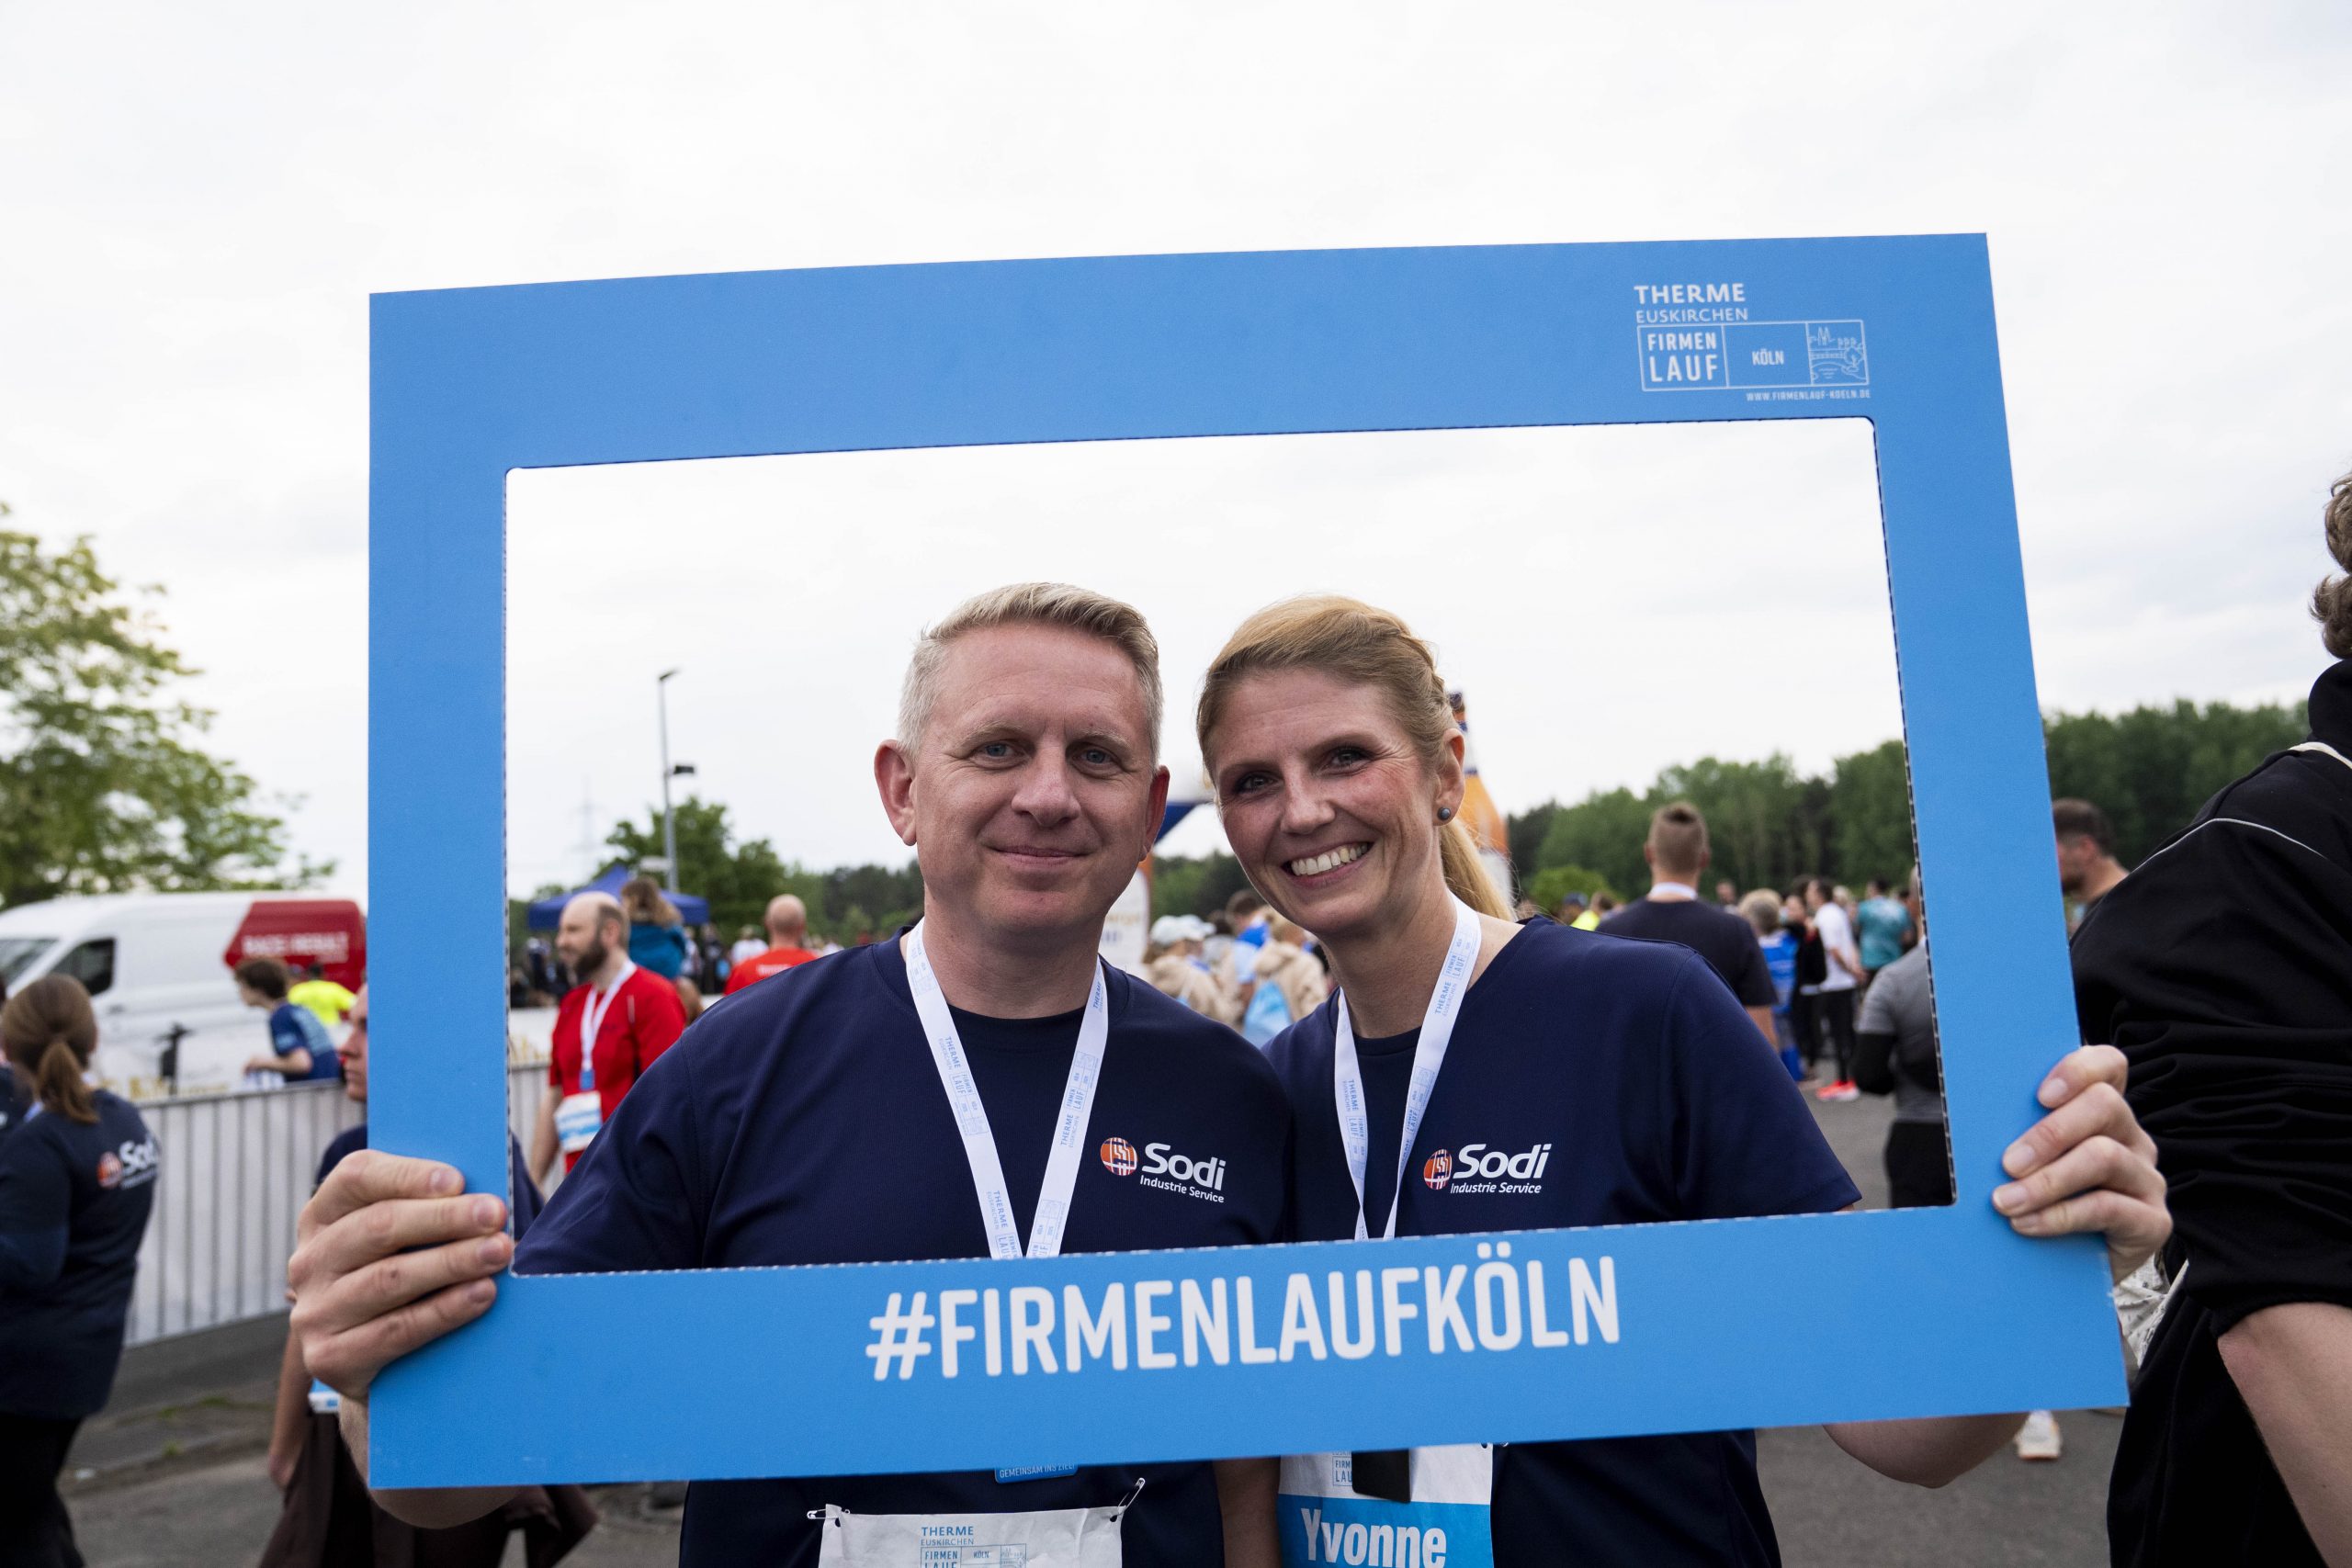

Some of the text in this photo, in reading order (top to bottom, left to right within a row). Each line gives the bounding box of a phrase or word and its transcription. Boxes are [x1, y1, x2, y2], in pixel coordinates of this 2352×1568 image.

[1634, 283, 1745, 304] THERME
[1635, 308, 1747, 323] EUSKIRCHEN
[1647, 333, 1716, 351] FIRMEN
[1752, 348, 1784, 366] KÖLN
[1649, 355, 1717, 382] LAUF
[1453, 956, 1465, 976] LAUF
[1435, 980, 1452, 1015] THERME
[945, 1036, 961, 1068] THERME
[952, 1076, 967, 1094] LAUF
[1073, 1091, 1084, 1110] LAUF
[1348, 1079, 1359, 1111] THERME
[1060, 1113, 1073, 1146] THERME
[1142, 1143, 1227, 1190] Sodi
[1453, 1144, 1552, 1179] Sodi
[1139, 1175, 1225, 1202] Industrie Service
[1451, 1182, 1542, 1194] Industrie Service
[994, 1190, 1008, 1228] THERME
[865, 1242, 1620, 1380] #FIRMENLAUFKÖLN
[1000, 1464, 1043, 1479] GEMEINSAM
[1045, 1462, 1057, 1473] INS
[1335, 1460, 1351, 1468] FIRM
[1335, 1470, 1352, 1483] LAU
[922, 1526, 974, 1537] THERME
[1301, 1507, 1447, 1568] Yvonne
[921, 1538, 974, 1546] EUSKIRCHEN
[925, 1551, 957, 1560] FIRMEN
[974, 1550, 989, 1559] KÖLN
